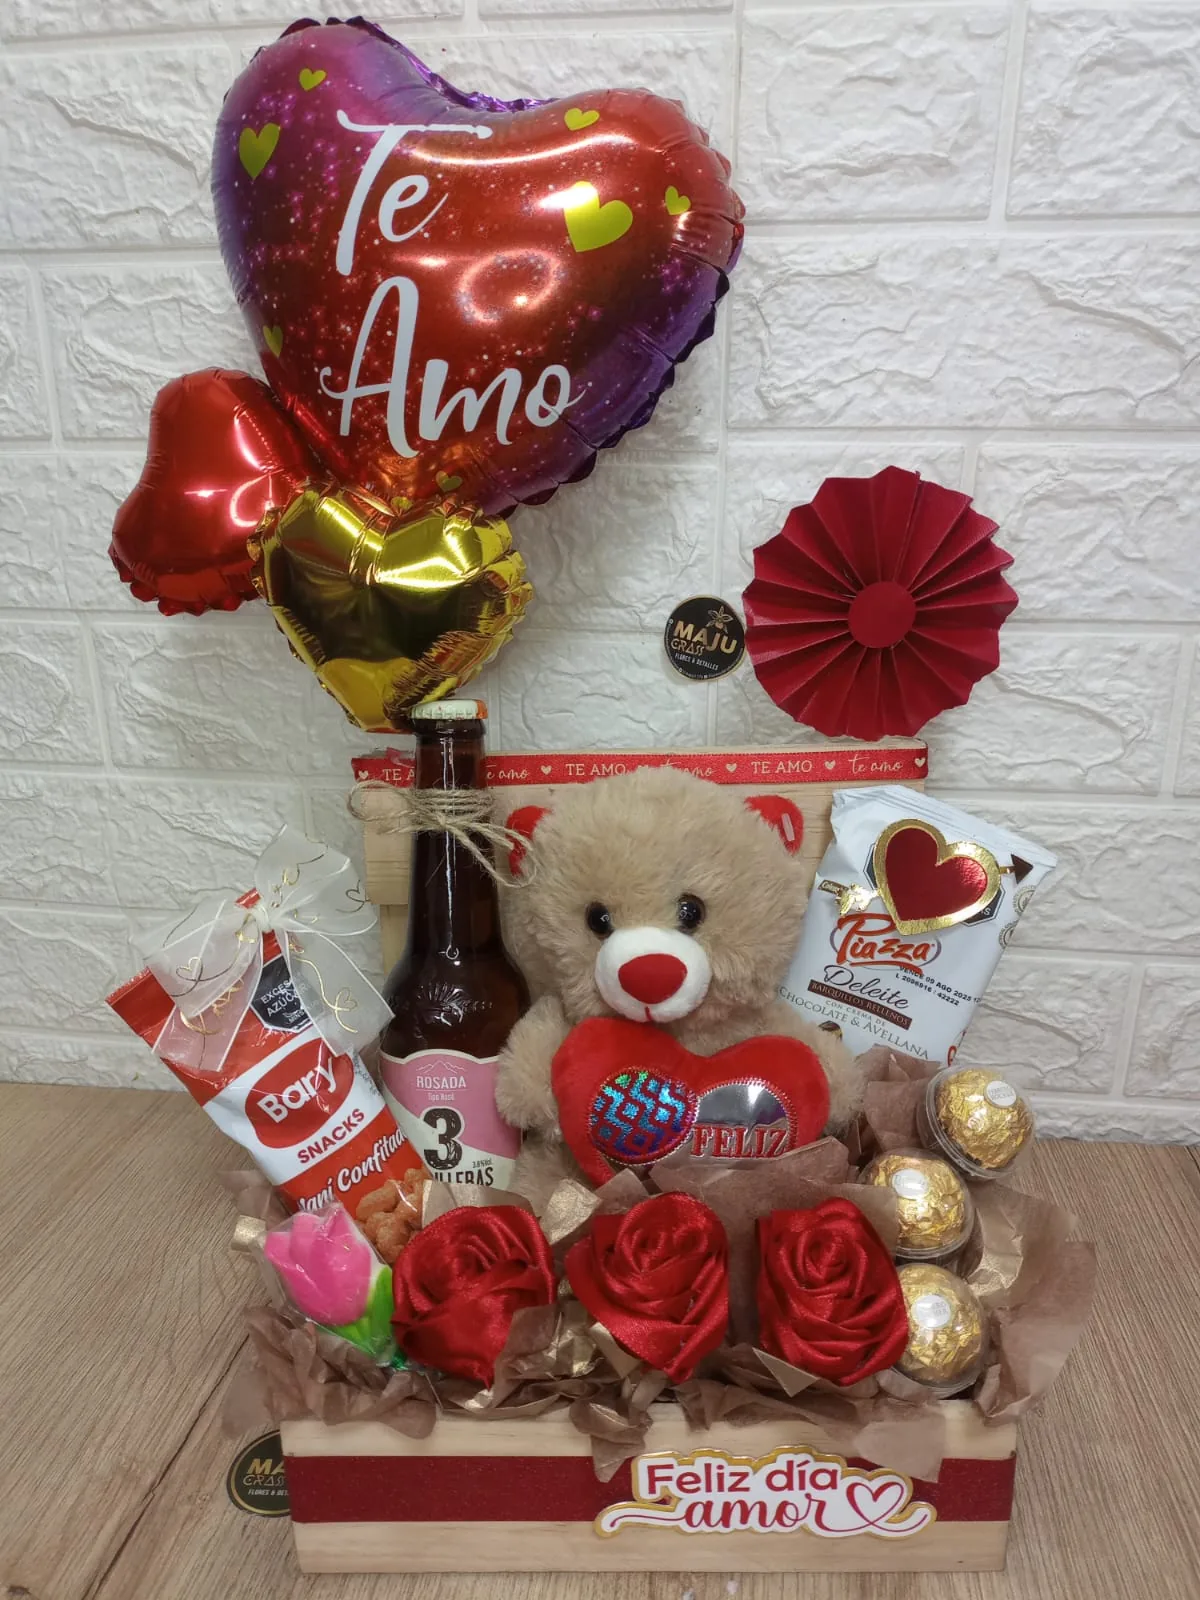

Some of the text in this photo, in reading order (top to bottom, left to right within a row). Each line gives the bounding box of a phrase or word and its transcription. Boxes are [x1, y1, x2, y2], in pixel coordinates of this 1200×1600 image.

[336, 109, 492, 276] Te
[320, 275, 587, 458] Amo
[673, 620, 737, 654] MAJU
[382, 768, 402, 781] TE
[498, 769, 529, 779] amo
[565, 763, 626, 776] TE AMO
[751, 760, 812, 774] TE AMO
[848, 754, 903, 774] te amo
[836, 912, 934, 965] Piazza
[824, 965, 910, 1009] Deleite
[936, 982, 952, 993] AGO
[780, 986, 848, 1022] CHOCOLATE
[851, 1017, 860, 1027] &
[863, 1021, 928, 1060] AVELLANA
[866, 1002, 908, 1026] RELLENOS
[256, 1057, 337, 1123] Bary
[416, 1076, 467, 1089] ROSADA
[296, 1107, 365, 1164] SNACKS
[423, 1108, 463, 1170] 3
[690, 1126, 789, 1158] FELIZ
[337, 1128, 408, 1192] Confitad
[247, 1458, 285, 1475] MA
[647, 1460, 839, 1495] Feliz día
